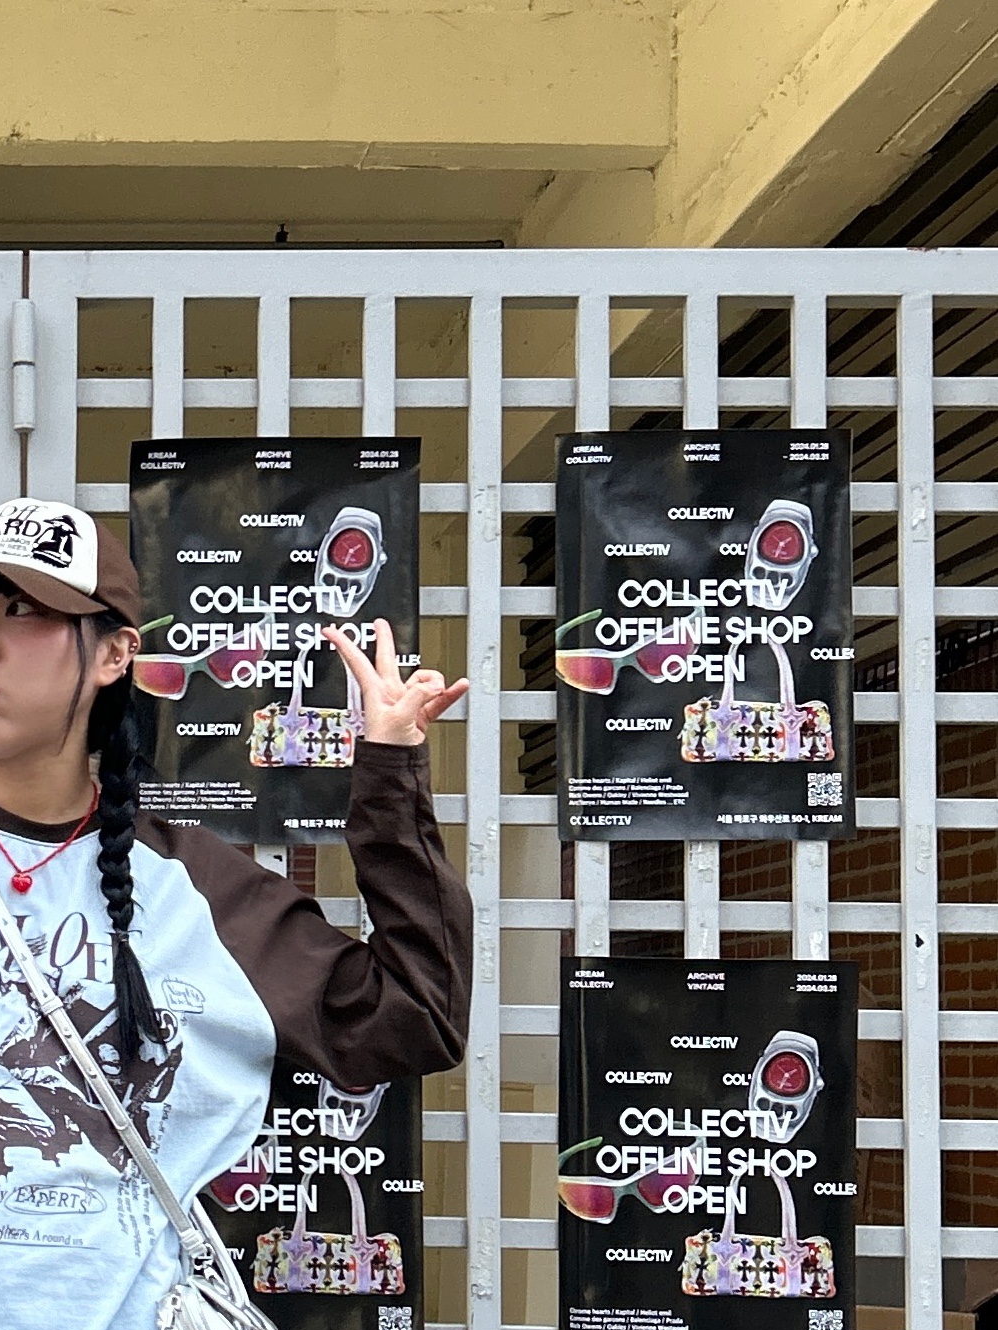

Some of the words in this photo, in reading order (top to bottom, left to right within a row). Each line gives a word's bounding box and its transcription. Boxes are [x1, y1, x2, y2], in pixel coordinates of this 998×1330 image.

[566, 456, 612, 464] COLLECTIV
[240, 515, 305, 527] COLLECTIV
[668, 508, 734, 520] COLLECTIV
[177, 551, 241, 562] COLLECTIV
[604, 544, 670, 556] COLLECTIV
[190, 586, 359, 617] COLLECTIV
[619, 579, 790, 610] COLLECTIV
[168, 623, 289, 653] OFFLINE
[596, 617, 720, 648] OFFLINE
[726, 616, 812, 646] SHOP
[231, 659, 313, 690] OPEN
[661, 652, 744, 685] OPEN
[177, 724, 241, 735] COLLECTIV
[606, 719, 672, 730] COLLECTIV
[671, 1036, 738, 1048] COLLECTIV
[606, 1071, 672, 1084] COLLECTIV
[620, 1108, 793, 1140] COLLECTIV
[299, 1147, 384, 1174] SHOP
[596, 1146, 721, 1176] OFFLINE
[728, 1149, 816, 1178] SHOP
[234, 1185, 316, 1214] OPEN
[662, 1185, 746, 1215] OPEN
[606, 1249, 672, 1261] COLLECTIV
